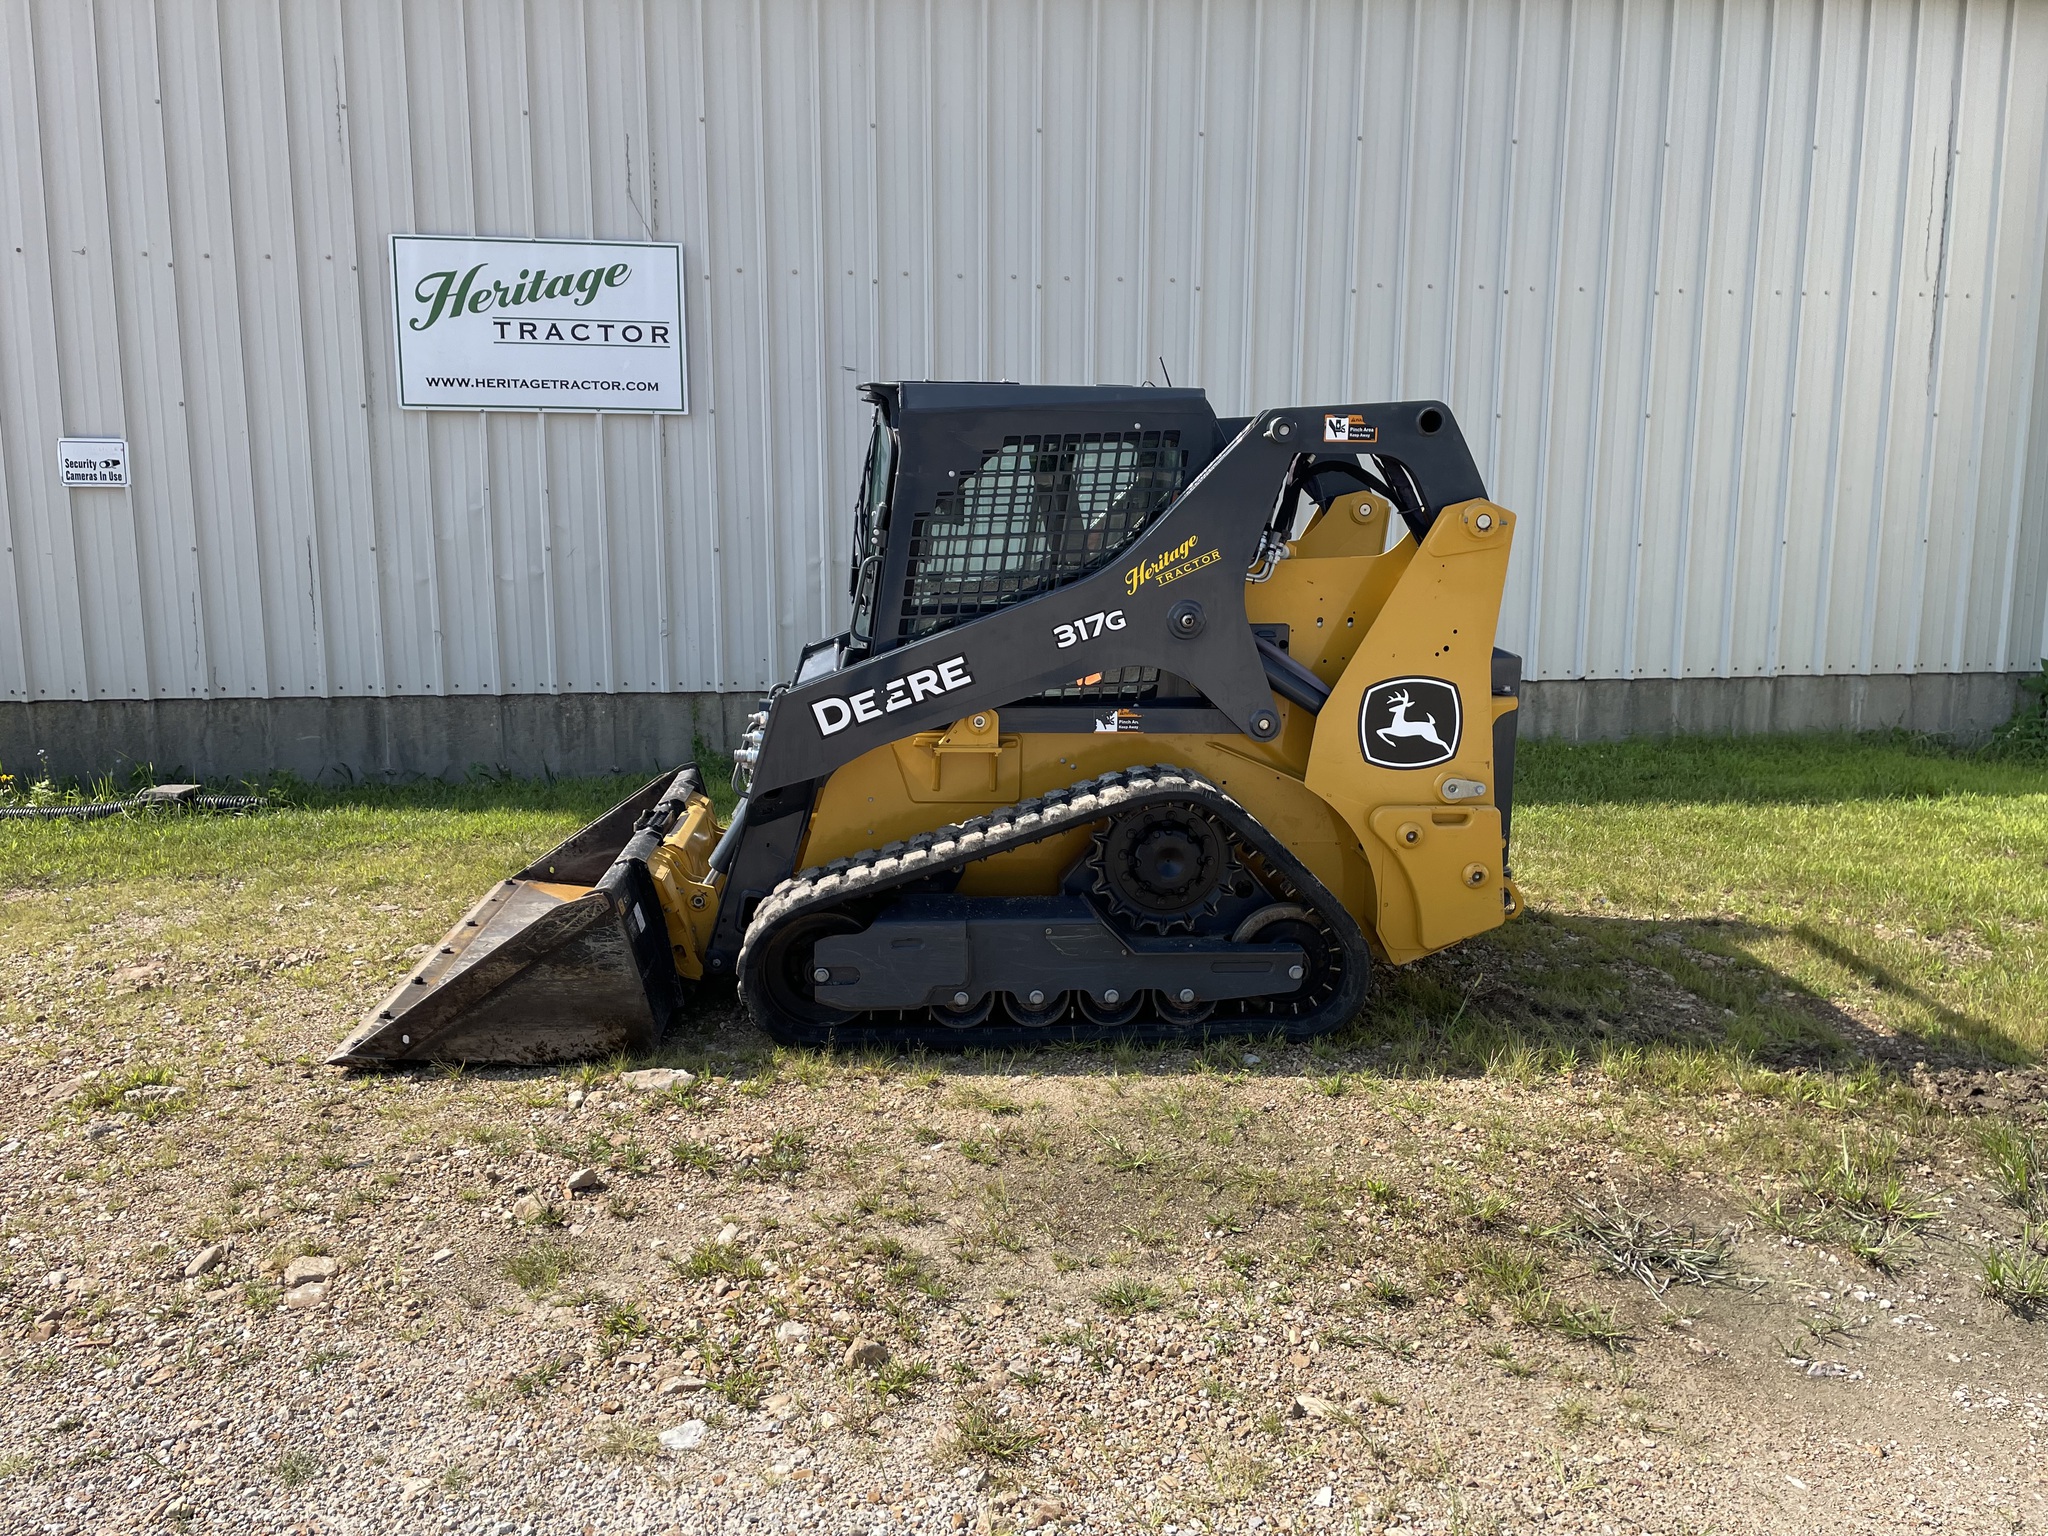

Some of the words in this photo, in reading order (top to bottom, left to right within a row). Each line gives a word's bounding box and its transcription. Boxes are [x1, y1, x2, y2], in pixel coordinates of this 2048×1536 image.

[409, 262, 633, 331] Heritage
[493, 320, 670, 344] TRACTOR
[426, 376, 659, 392] WWW.HERITAGETRACTOR.COM
[64, 458, 97, 471] Security
[65, 470, 98, 481] Cameras
[99, 471, 107, 481] In
[108, 471, 122, 481] Use
[1124, 534, 1198, 596] Heritage
[1155, 550, 1221, 586] TRACTOR
[1053, 609, 1127, 649] 317G
[811, 655, 973, 737] DEERE
